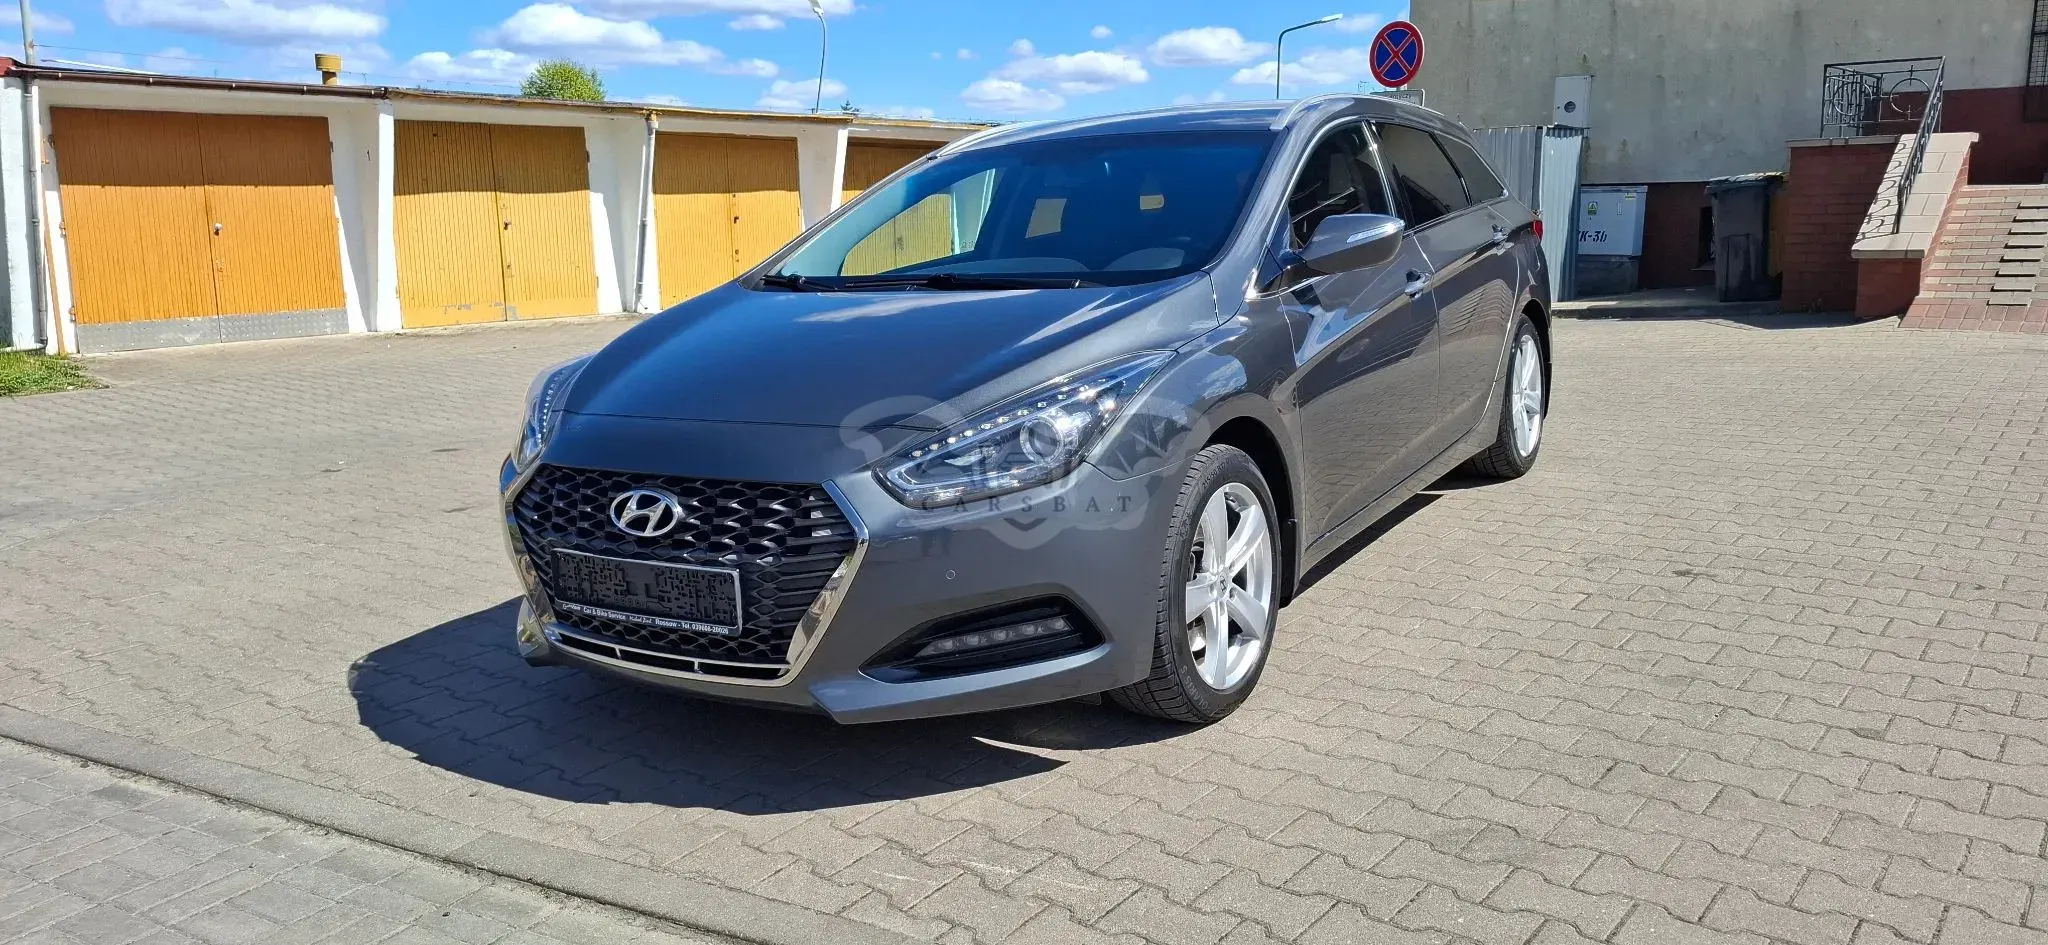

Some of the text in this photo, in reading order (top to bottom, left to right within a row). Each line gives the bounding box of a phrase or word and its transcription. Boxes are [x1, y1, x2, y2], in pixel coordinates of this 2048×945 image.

[1578, 230, 1608, 242] K-3b
[583, 606, 592, 614] Car
[597, 609, 607, 617] Bike
[608, 611, 626, 621] Service
